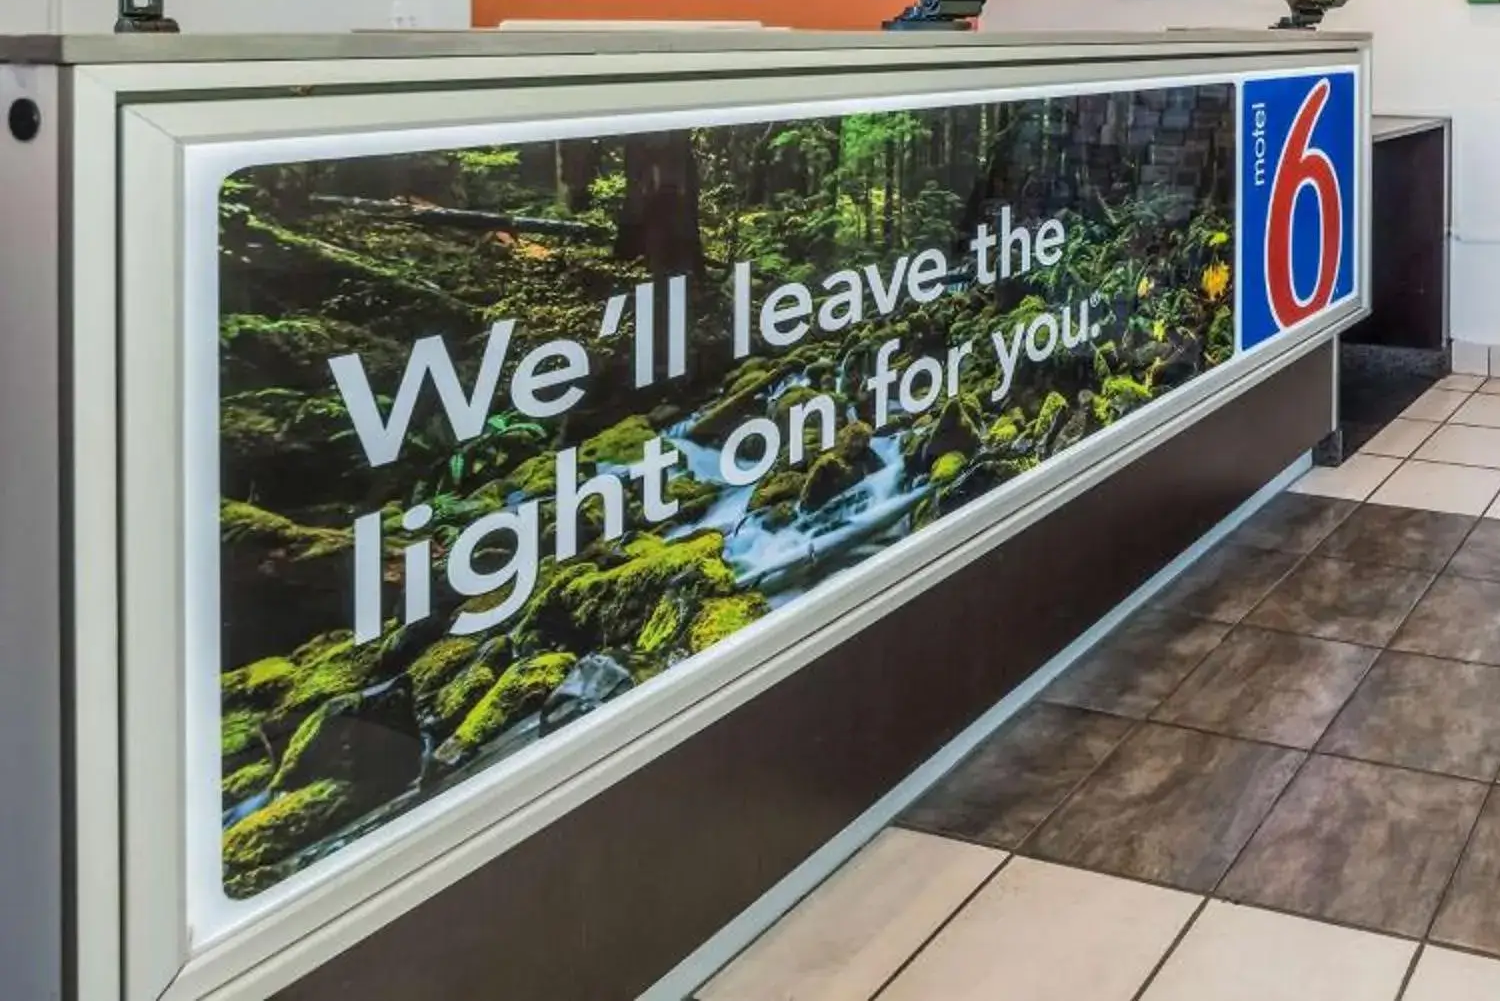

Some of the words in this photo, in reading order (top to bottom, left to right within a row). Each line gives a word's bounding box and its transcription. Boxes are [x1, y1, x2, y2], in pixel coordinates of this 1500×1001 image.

[1252, 102, 1267, 187] motel
[1264, 77, 1343, 330] 6
[329, 275, 687, 468] We'll
[731, 247, 948, 361] leave
[968, 206, 1066, 286] the
[352, 436, 681, 647] light
[719, 396, 837, 487] on
[865, 337, 973, 430] for
